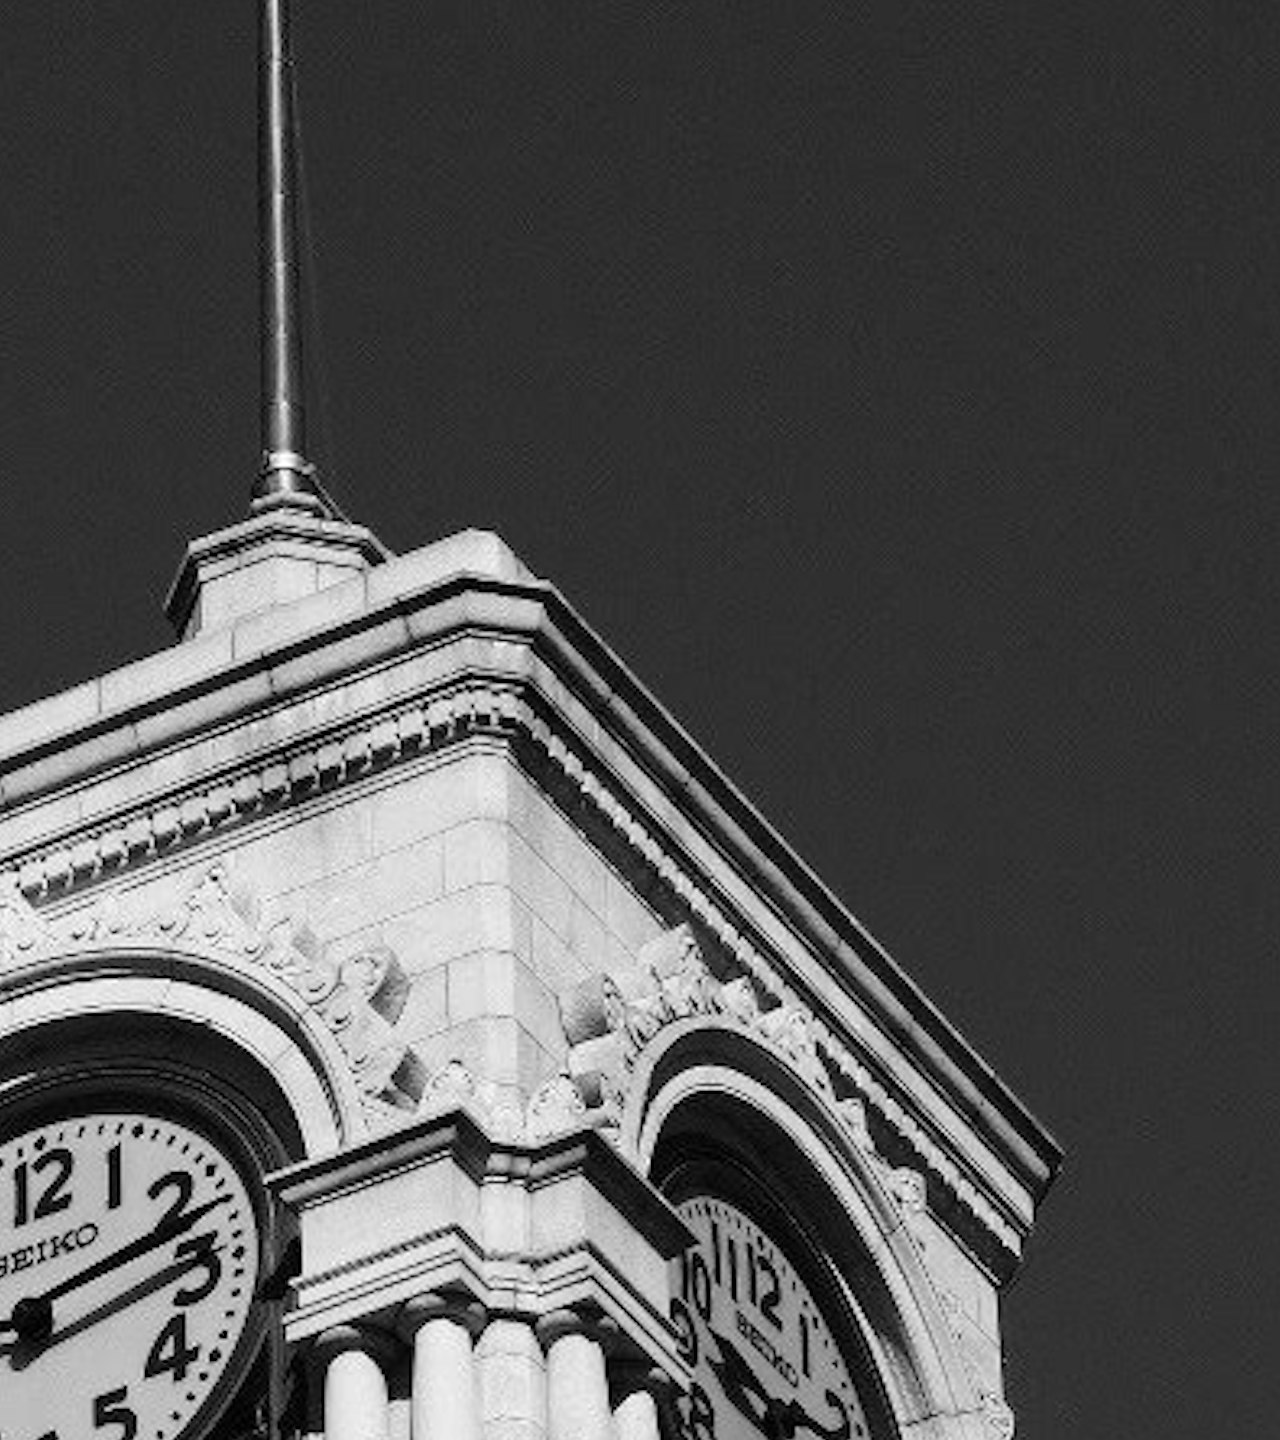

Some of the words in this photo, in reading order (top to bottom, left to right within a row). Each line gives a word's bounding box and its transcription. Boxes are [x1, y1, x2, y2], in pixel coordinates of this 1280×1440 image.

[14, 1149, 73, 1228] 12
[109, 1141, 121, 1209] 1
[147, 1171, 193, 1242] 2
[174, 1230, 222, 1305] 3
[711, 1222, 738, 1303] 11
[747, 1242, 782, 1331] 12
[144, 1314, 198, 1382] 4
[799, 1315, 810, 1380] 1
